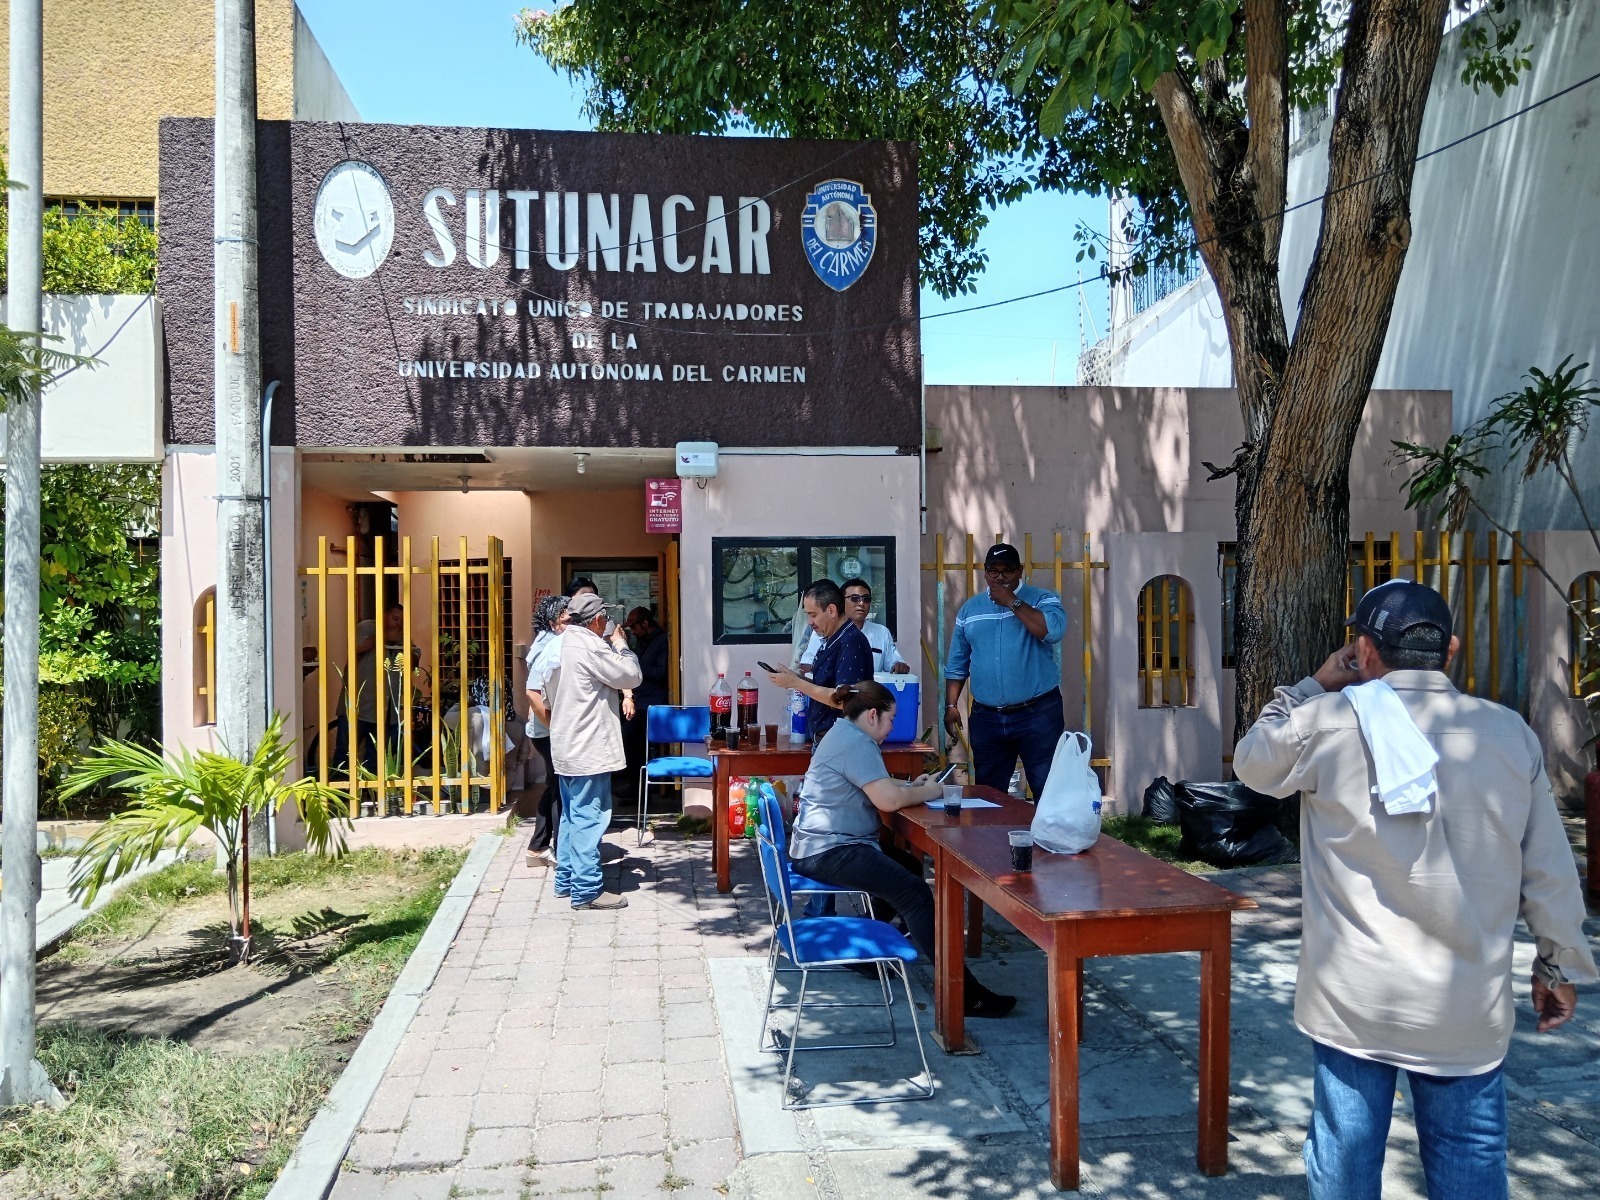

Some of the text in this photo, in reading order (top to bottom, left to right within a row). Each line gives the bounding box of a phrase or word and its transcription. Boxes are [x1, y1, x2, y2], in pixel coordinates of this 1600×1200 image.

[816, 183, 857, 195] UNIVERSIDAD
[422, 187, 771, 275] SUTUNACAR
[806, 237, 872, 277] DEL CARMEN
[403, 299, 803, 322] SINDICATO UNICO DE TRABAJADORES
[572, 332, 638, 350] DE LA
[398, 360, 806, 383] UNIVERSIDAD AUTONOMA DEL CARMEN
[230, 456, 240, 483] 2001
